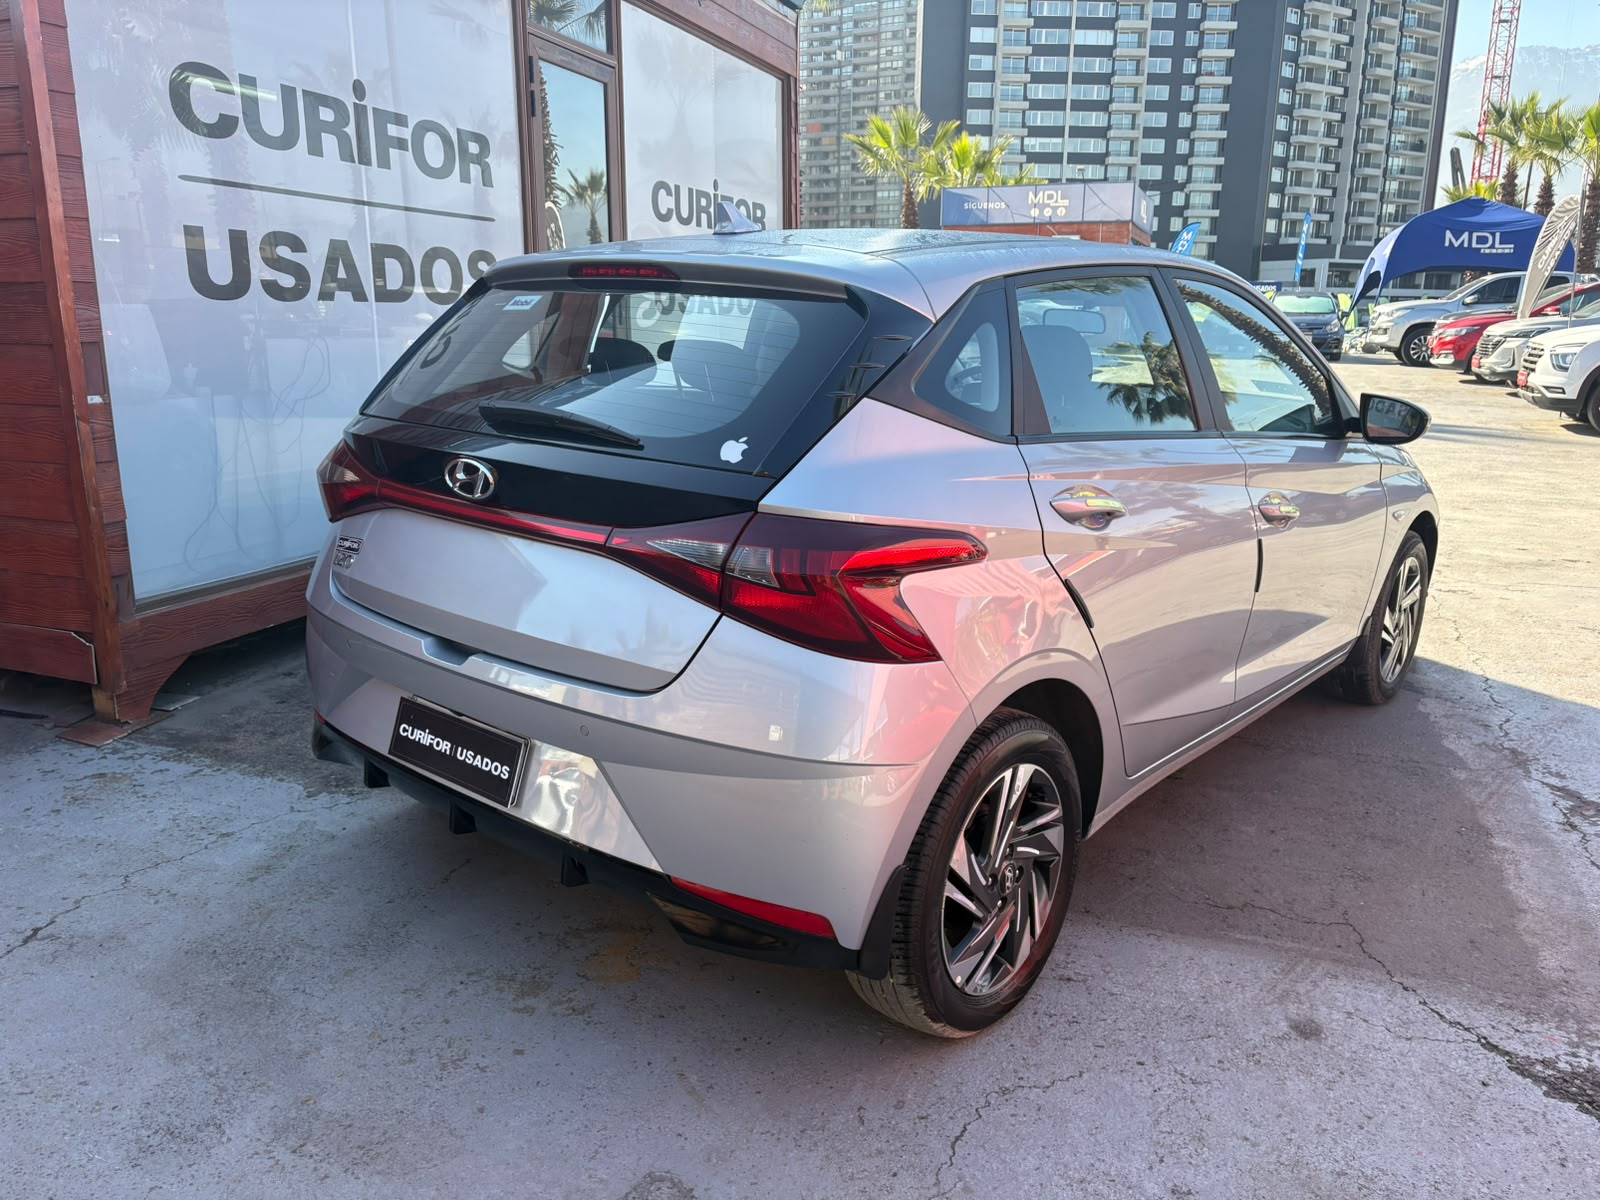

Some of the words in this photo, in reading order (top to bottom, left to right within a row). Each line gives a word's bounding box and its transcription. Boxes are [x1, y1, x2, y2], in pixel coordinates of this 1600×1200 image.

[1028, 190, 1069, 204] MDL
[1444, 230, 1514, 248] MDL
[456, 746, 510, 780] USADOS
